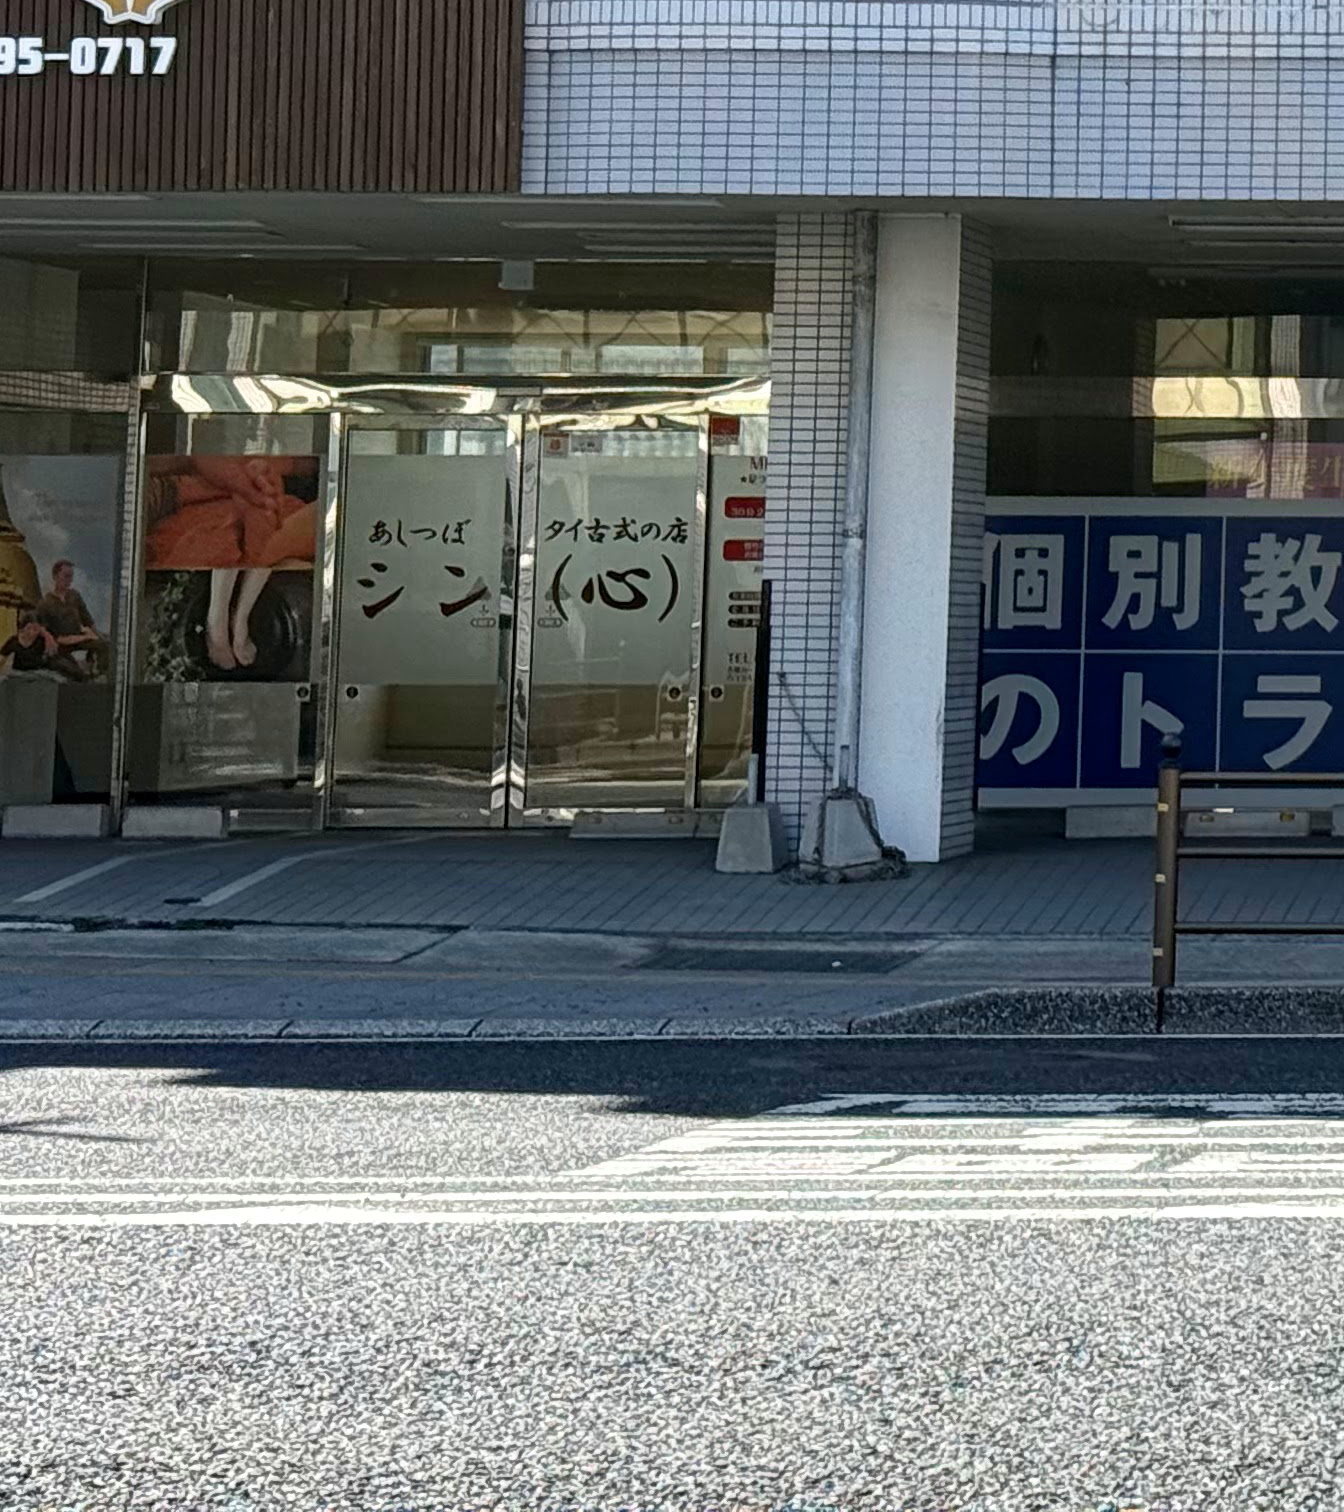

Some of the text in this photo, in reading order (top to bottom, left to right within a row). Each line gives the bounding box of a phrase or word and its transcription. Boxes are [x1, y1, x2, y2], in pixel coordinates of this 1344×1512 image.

[545, 516, 689, 545] タイ古式の店
[357, 562, 488, 619] シン
[552, 554, 679, 623] (心)
